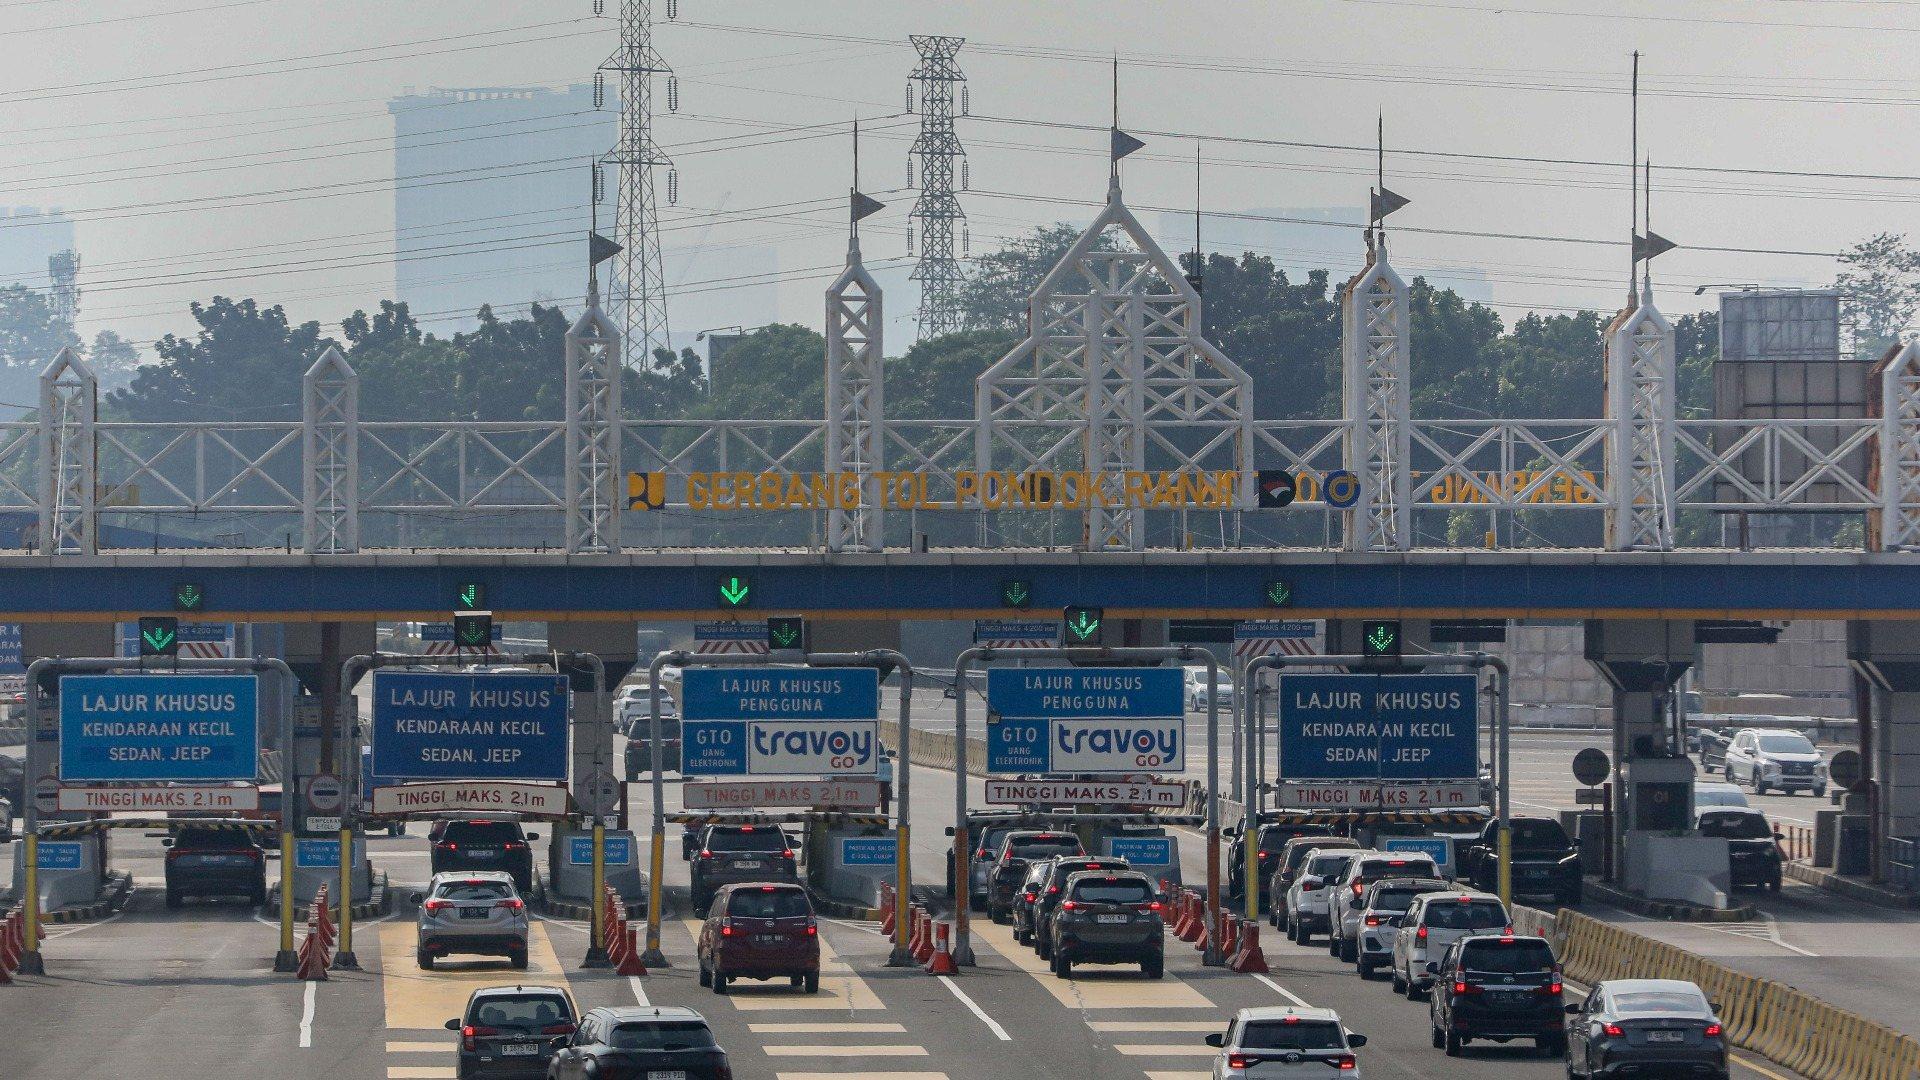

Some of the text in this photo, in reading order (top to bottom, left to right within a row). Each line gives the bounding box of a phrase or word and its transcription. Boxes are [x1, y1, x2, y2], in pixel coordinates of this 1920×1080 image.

[687, 471, 860, 510] GERBANG
[872, 471, 940, 510] TOL
[955, 471, 1108, 510] PONDOK
[722, 679, 842, 694] LAJUR KHUSUS
[1026, 676, 1142, 690] LAJUR KHUSUS
[82, 694, 236, 712] LAJUR KHUSUS
[391, 688, 550, 708] LAJUR KHUSUS
[740, 698, 823, 712] PENGGUNA
[1043, 696, 1129, 709] PENGGUNA
[1296, 693, 1461, 710] LAJUR KHUSUS
[83, 722, 235, 736] KENDARAAN KECIL
[396, 720, 545, 736] KENDARAAN KECIL
[1002, 728, 1037, 742] GTO
[1410, 724, 1454, 736] KECIL
[697, 730, 731, 744] GTO
[1058, 724, 1176, 764] travoy
[754, 726, 870, 765] travoy
[170, 747, 211, 760] JEEP
[482, 749, 522, 762] JEEP
[1136, 754, 1160, 766] GO
[1392, 748, 1431, 762] JEEP
[690, 759, 737, 768] ELEKTRONIK
[830, 756, 854, 768] GO
[996, 757, 1042, 765] ELEKTRONIK
[86, 792, 136, 806] TINGGI
[142, 792, 188, 806] MAKS.
[396, 792, 445, 806] TINGGI
[456, 790, 504, 804] MAKS.
[704, 788, 757, 801] TINGGI
[994, 786, 1057, 799] TINGGI
[1064, 787, 1124, 800] MAKS.
[1296, 790, 1348, 803] TINGGI
